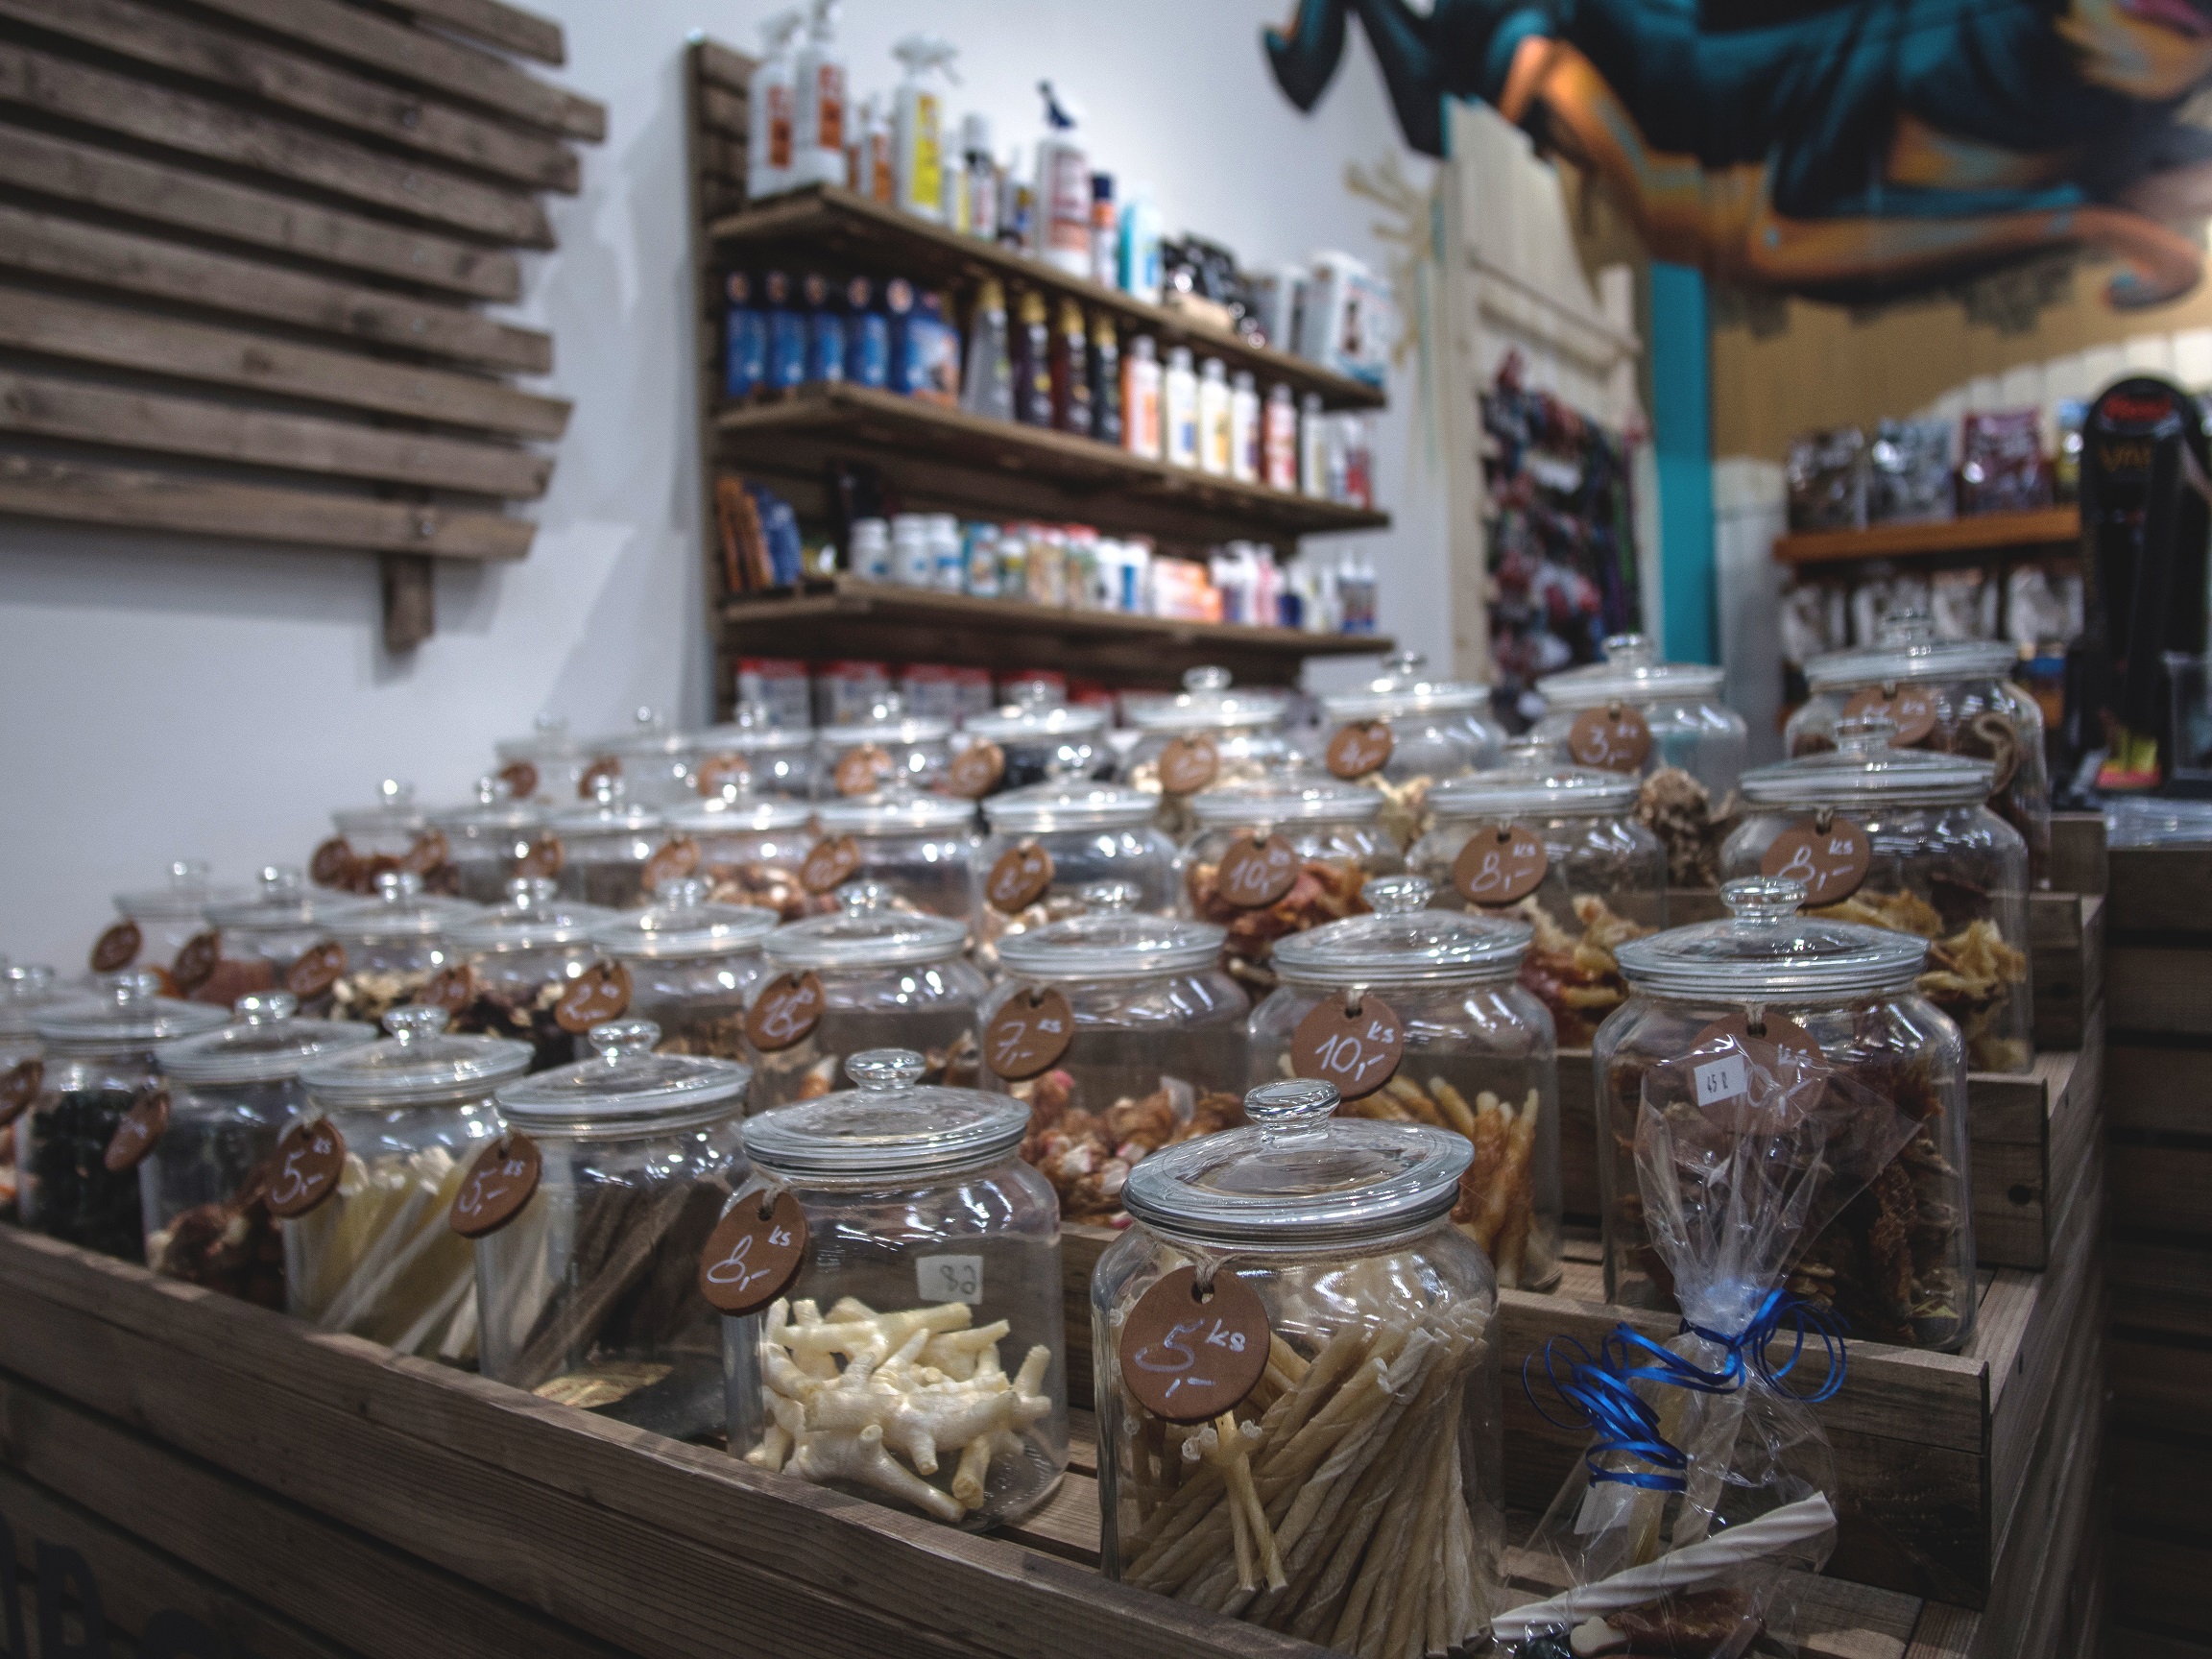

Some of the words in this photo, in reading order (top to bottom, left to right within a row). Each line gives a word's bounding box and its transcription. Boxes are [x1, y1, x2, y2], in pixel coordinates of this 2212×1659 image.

[1470, 852, 1533, 892] 8,-
[1315, 1034, 1385, 1081] 10,-
[1366, 1021, 1394, 1044] ks
[272, 1149, 324, 1204] 5,-
[459, 1168, 508, 1216] 5,-
[707, 1235, 771, 1292] 8,-
[767, 1226, 792, 1247] ks
[1205, 1319, 1246, 1353] ks
